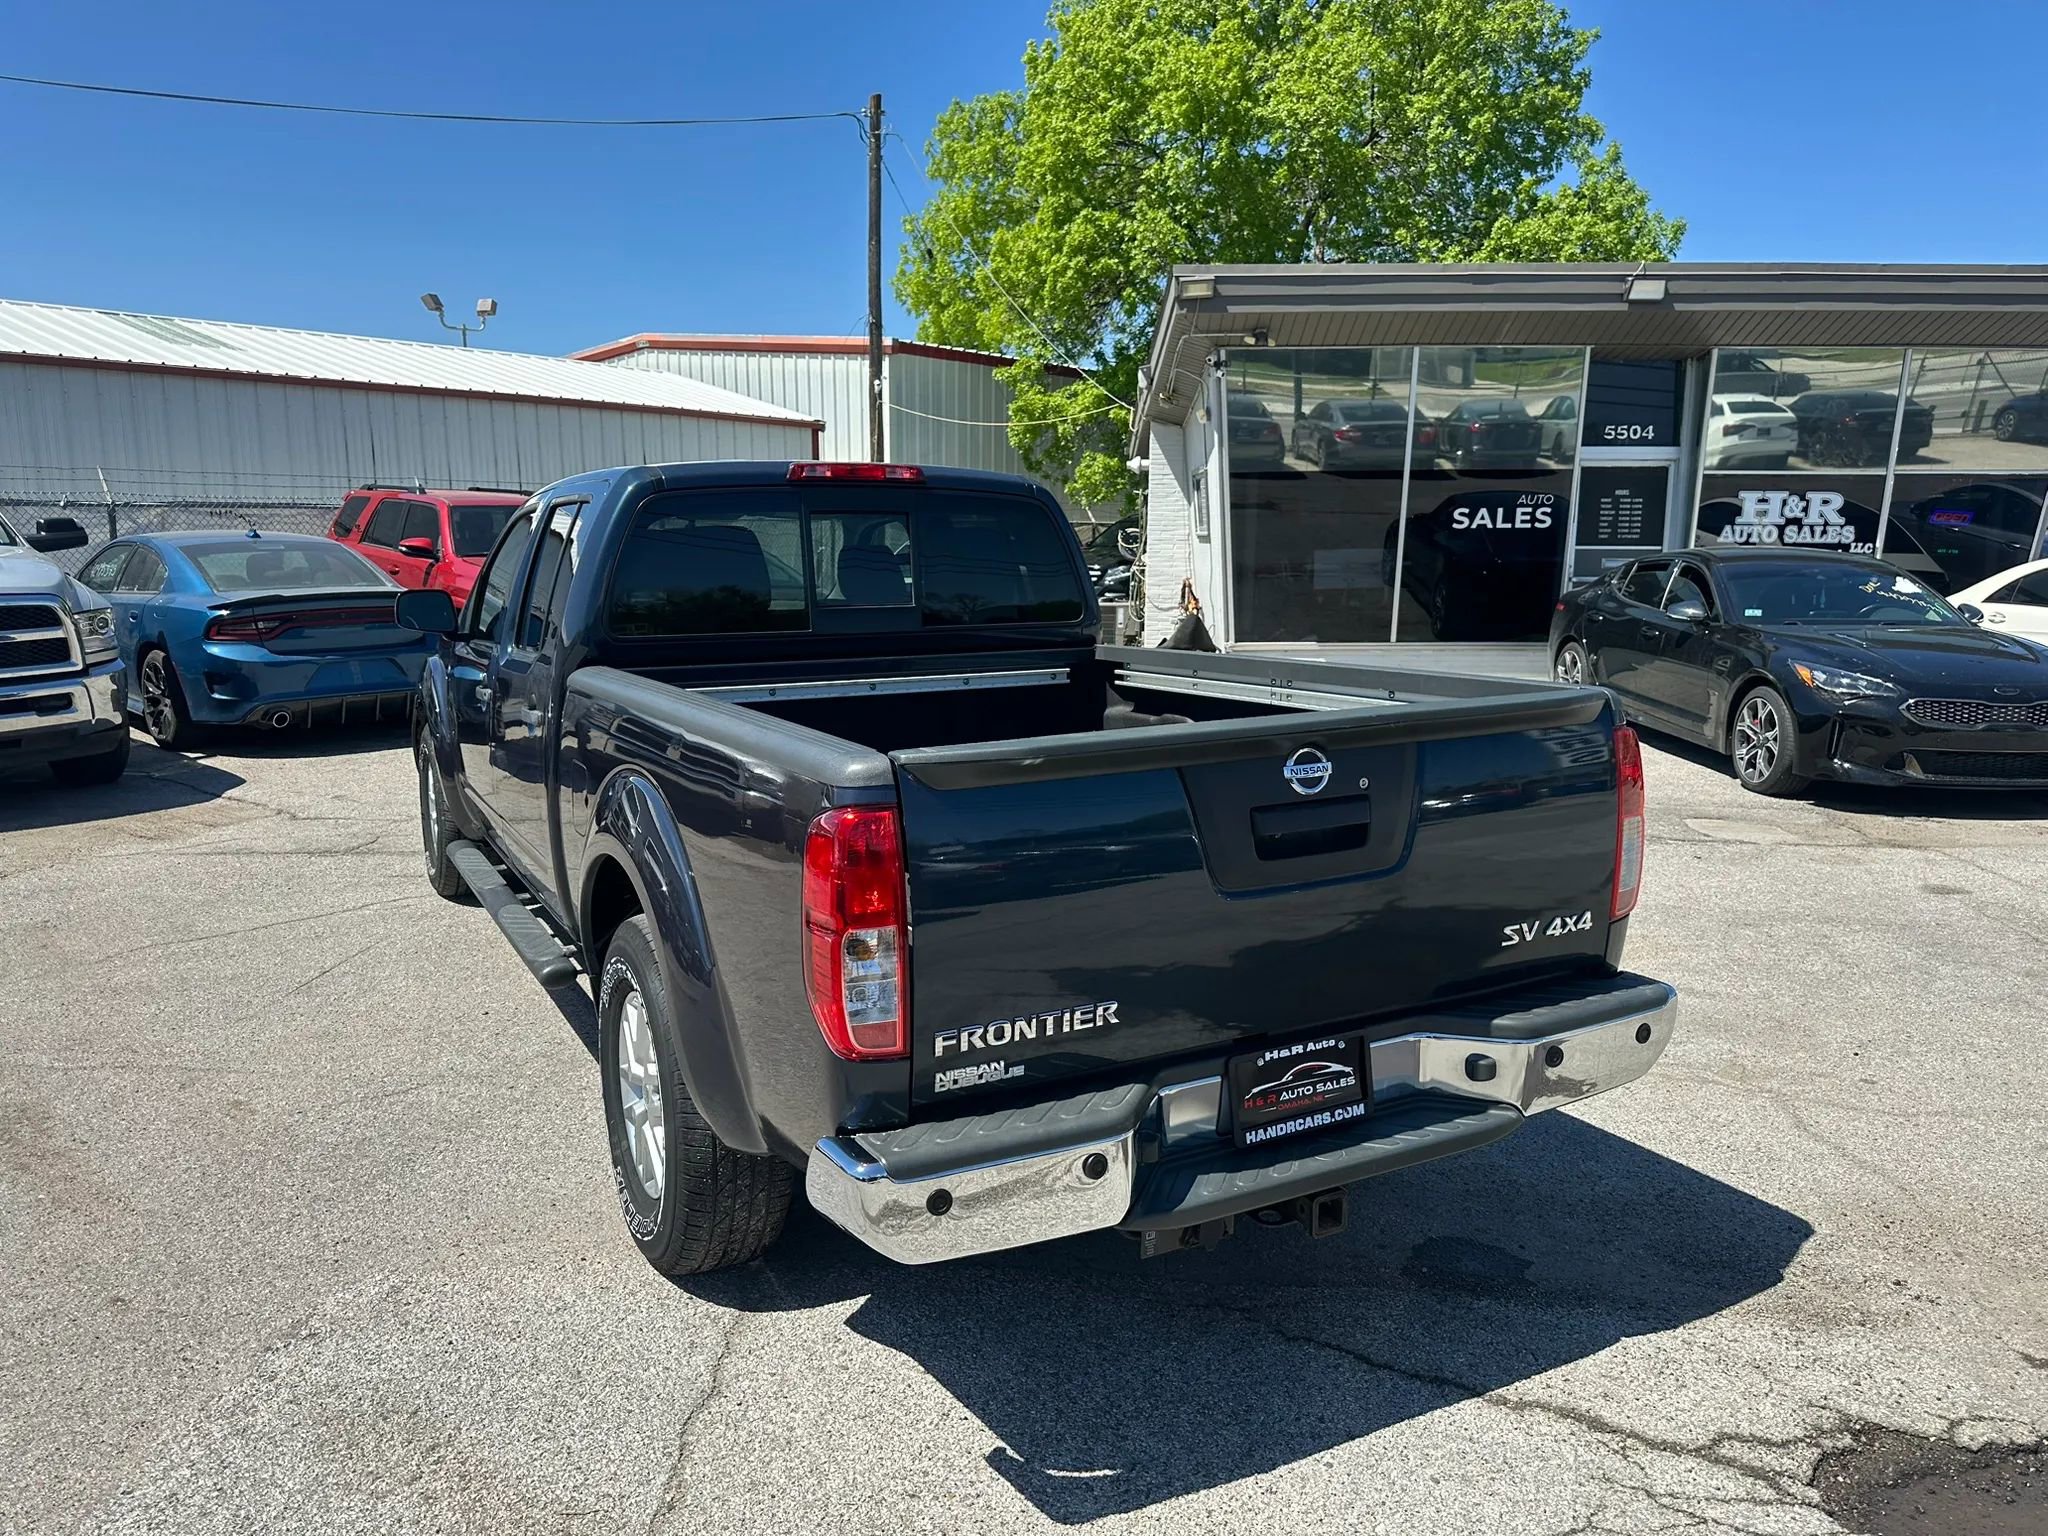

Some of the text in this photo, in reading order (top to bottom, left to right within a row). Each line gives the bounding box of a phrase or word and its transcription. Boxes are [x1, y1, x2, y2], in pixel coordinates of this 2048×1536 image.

[1603, 424, 1655, 440] 5504
[1517, 494, 1554, 505] AUTO
[1735, 490, 1846, 525] H&R
[1451, 507, 1553, 530] SALES
[1717, 525, 1856, 544] AUTO SALES
[1848, 542, 1874, 554] LLC
[1290, 764, 1329, 776] NISSAN
[1501, 920, 1540, 947] SV
[934, 1000, 1120, 1058] FRONTIER
[1264, 1039, 1336, 1062] H&R Auto
[934, 1060, 1005, 1083] NISSAN
[1244, 1099, 1253, 1109] H
[1267, 1094, 1277, 1104] R
[1280, 1085, 1313, 1101] AUTO
[1316, 1075, 1356, 1093] SALES
[1245, 1103, 1365, 1145] HANDRCARS.COM
